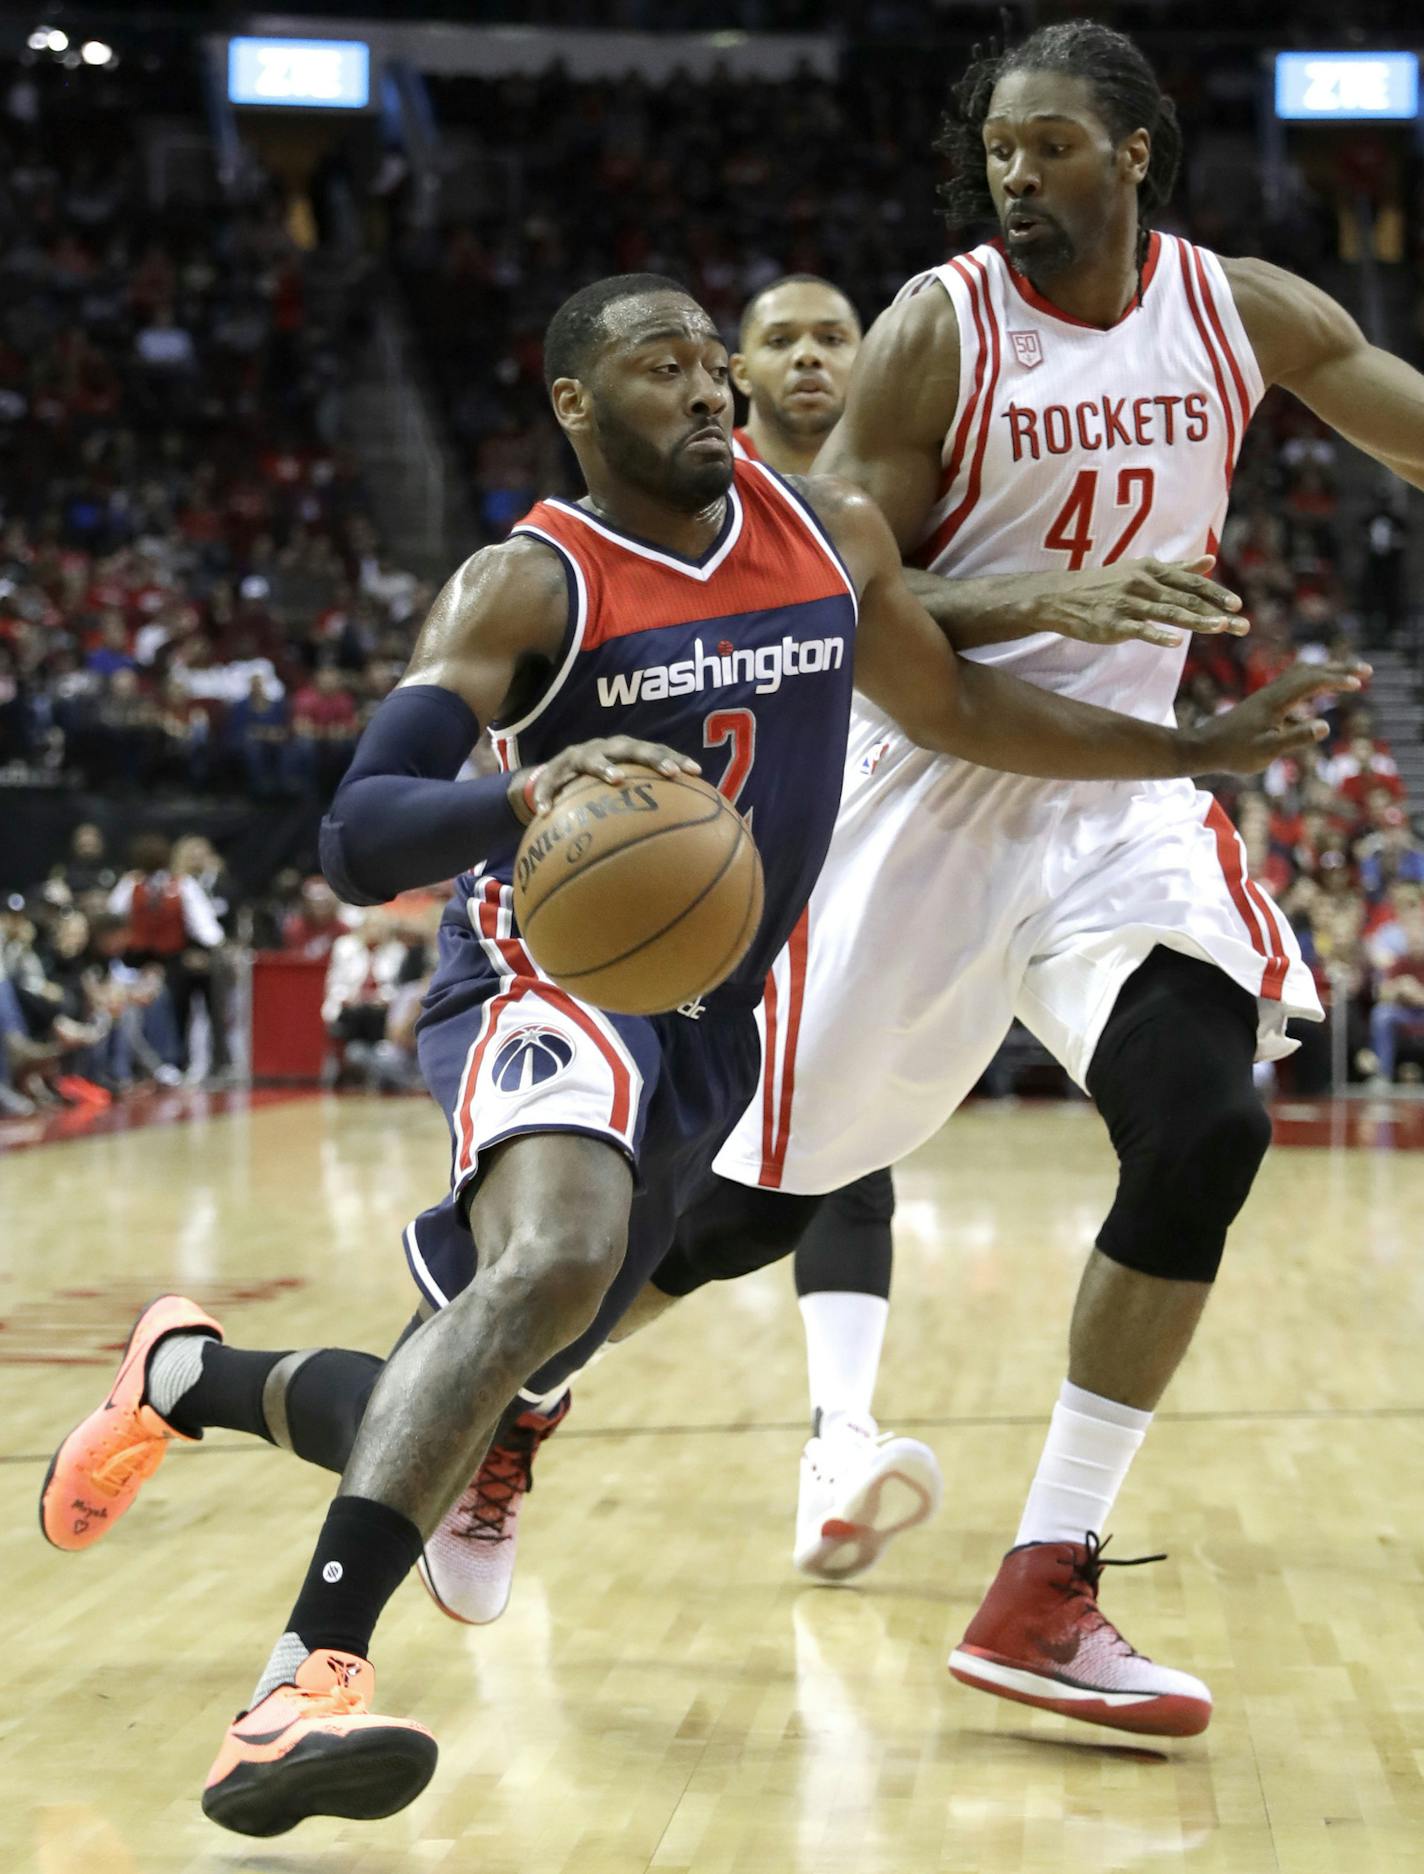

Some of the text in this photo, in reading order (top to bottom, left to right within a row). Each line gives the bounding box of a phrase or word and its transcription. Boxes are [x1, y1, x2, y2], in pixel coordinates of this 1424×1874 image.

[1013, 335, 1037, 353] 50
[1001, 393, 1210, 462] ROCKETS
[1043, 467, 1155, 572] 42
[597, 636, 844, 707] washington
[703, 707, 757, 831] 2
